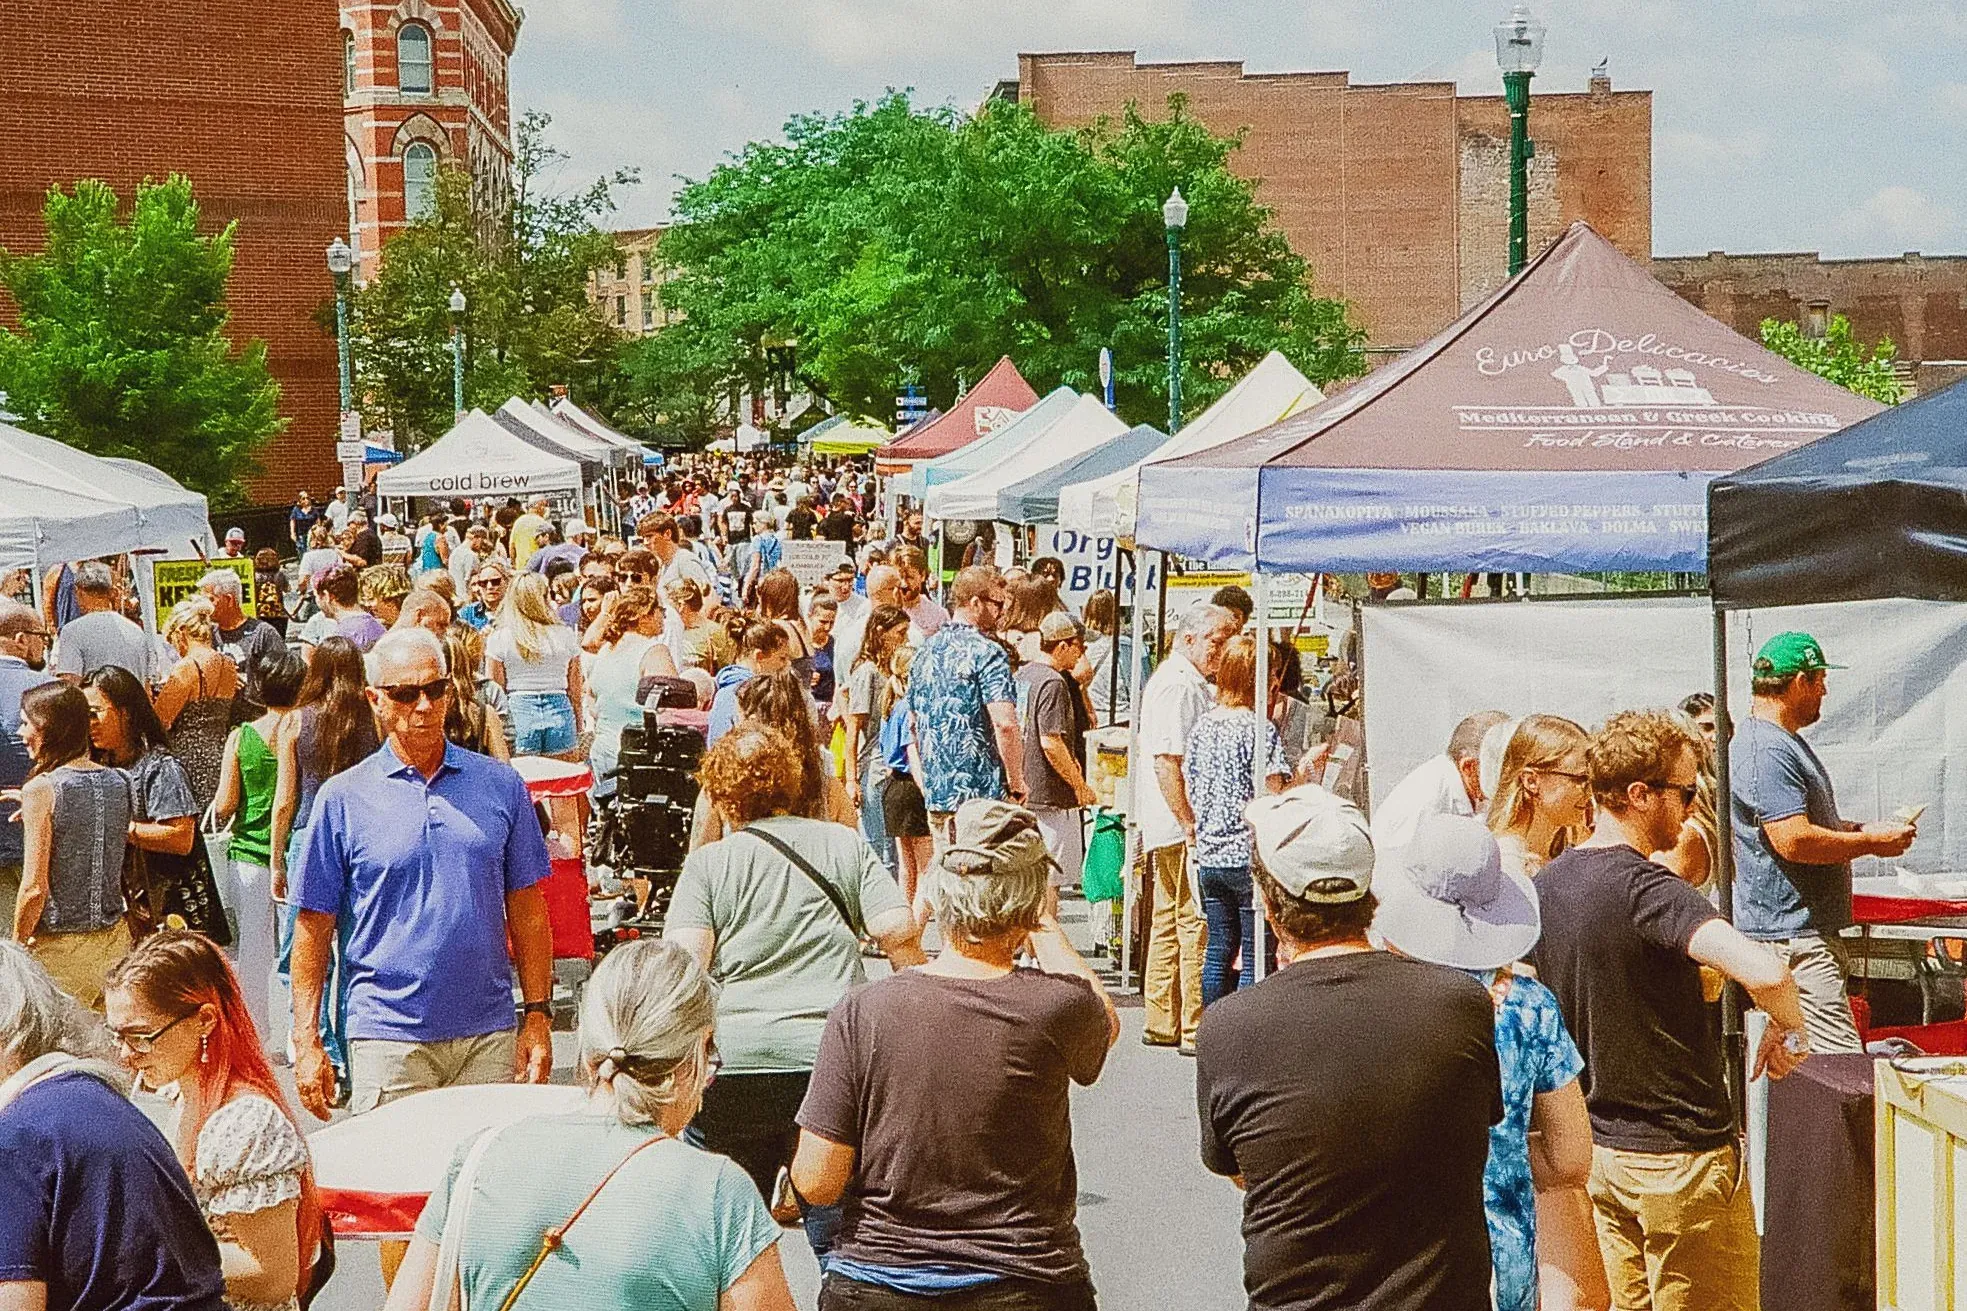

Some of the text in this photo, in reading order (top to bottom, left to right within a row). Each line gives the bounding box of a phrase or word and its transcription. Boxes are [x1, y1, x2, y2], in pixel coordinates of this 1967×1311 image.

[1475, 328, 1778, 384] Euro Delicacies
[1458, 411, 1638, 424] Mediterranean
[1665, 411, 1738, 423] Greek
[1740, 410, 1841, 428] Cooking
[1523, 430, 1594, 448] Food
[1592, 430, 1673, 449] Stand
[1672, 432, 1694, 446] &
[429, 472, 530, 491] cold brew
[1602, 521, 1657, 534] DOLMA
